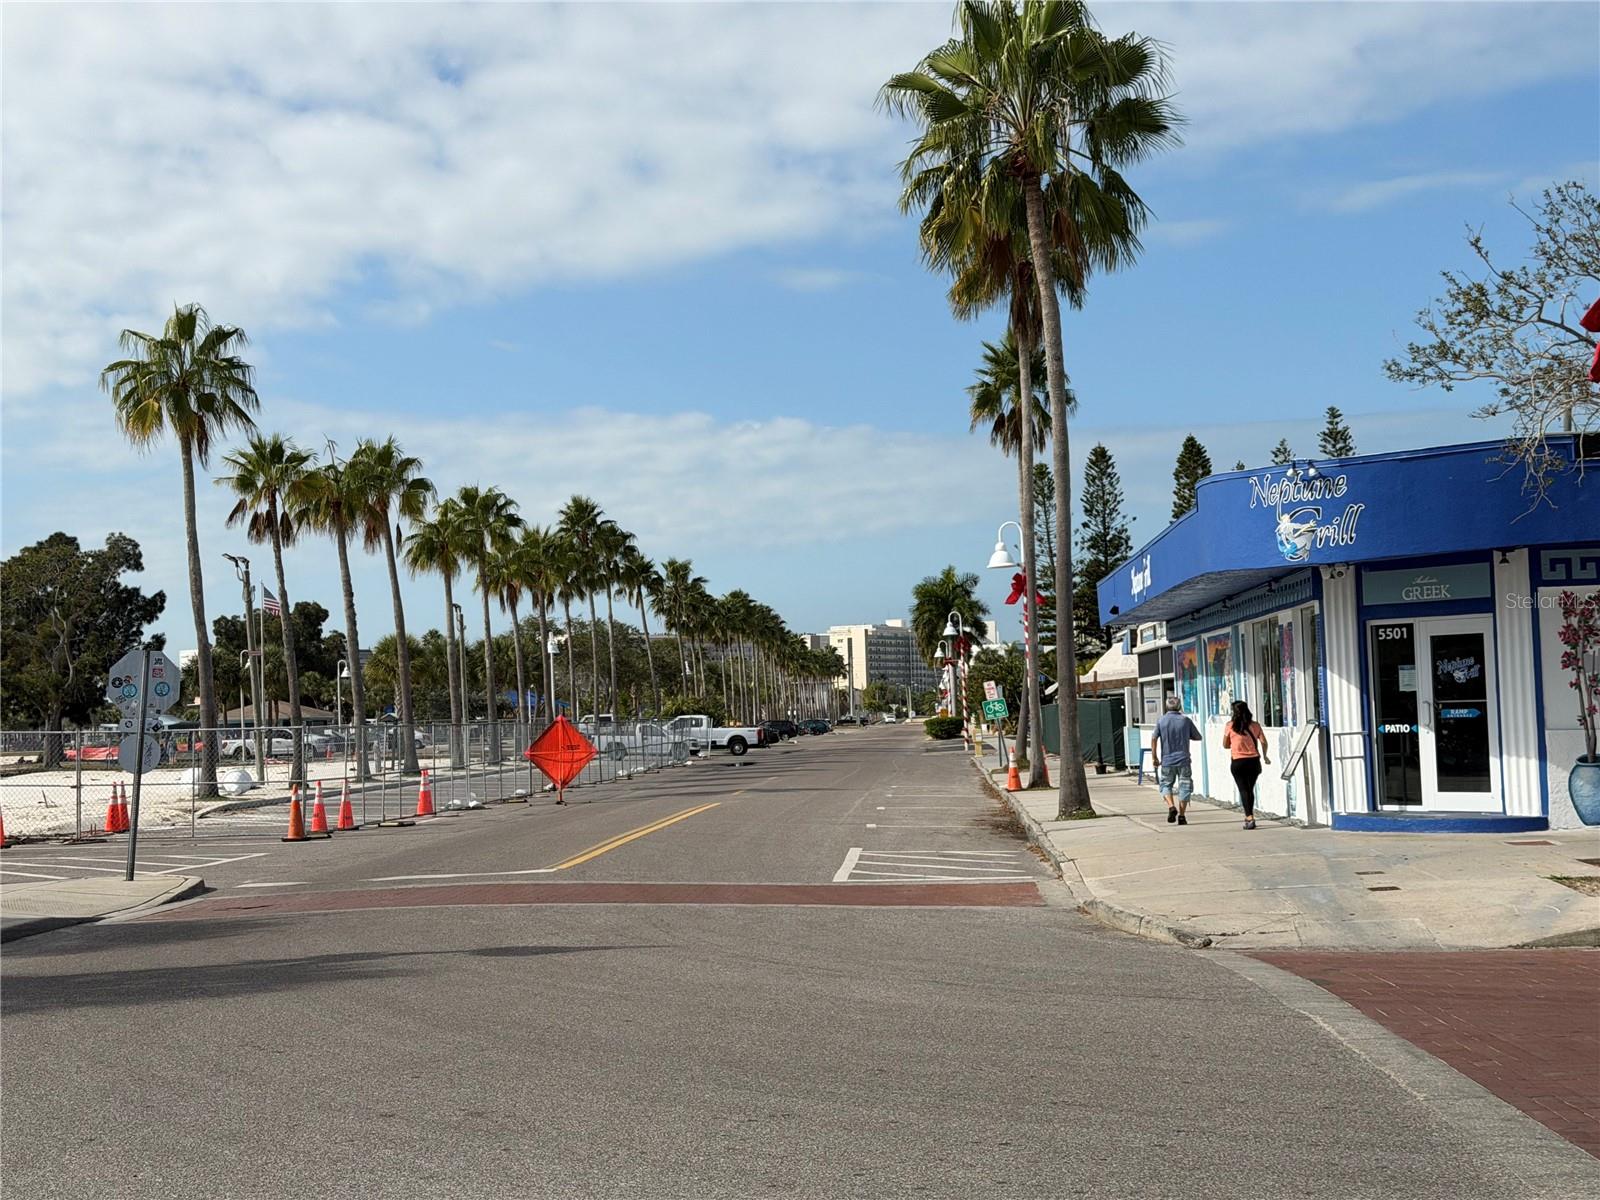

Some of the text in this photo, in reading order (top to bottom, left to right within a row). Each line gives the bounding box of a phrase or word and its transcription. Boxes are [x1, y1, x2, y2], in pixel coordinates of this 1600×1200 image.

[1248, 470, 1347, 519] Neptune
[1275, 503, 1366, 562] Grill
[1402, 584, 1451, 600] GREEK
[1378, 627, 1408, 640] 5501
[1384, 724, 1411, 733] PATIO
